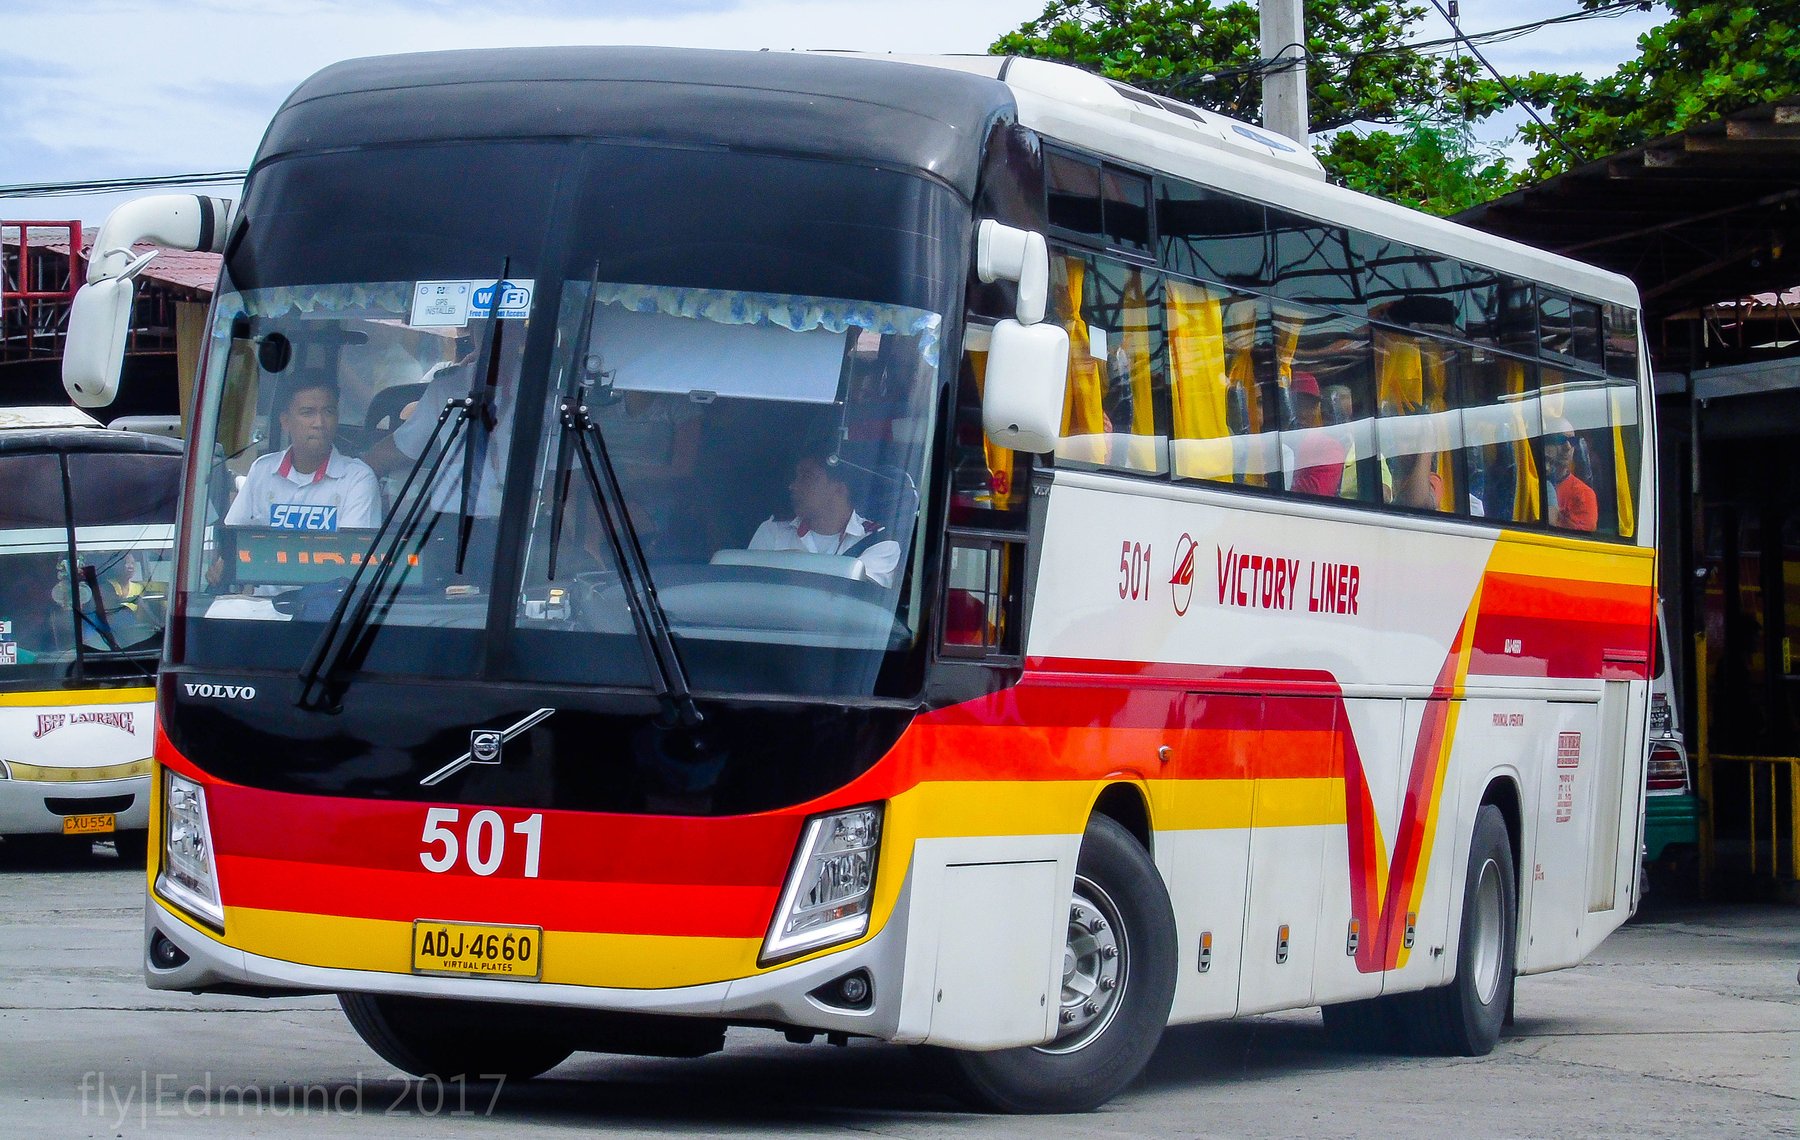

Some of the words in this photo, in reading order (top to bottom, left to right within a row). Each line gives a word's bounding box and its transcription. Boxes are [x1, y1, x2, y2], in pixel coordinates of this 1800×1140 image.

[435, 298, 448, 306] GPS
[478, 292, 524, 304] WFi
[271, 505, 336, 530] SCTEX
[1119, 540, 1151, 601] 501
[1217, 543, 1300, 611] VICTORY
[1309, 561, 1360, 616] LINER
[184, 683, 256, 700] VOLVO
[33, 714, 66, 739] JEFF
[69, 712, 136, 736] LAURENCE
[419, 807, 543, 878] 501
[443, 960, 478, 970] VIRTUAL
[481, 962, 512, 972] PLATES
